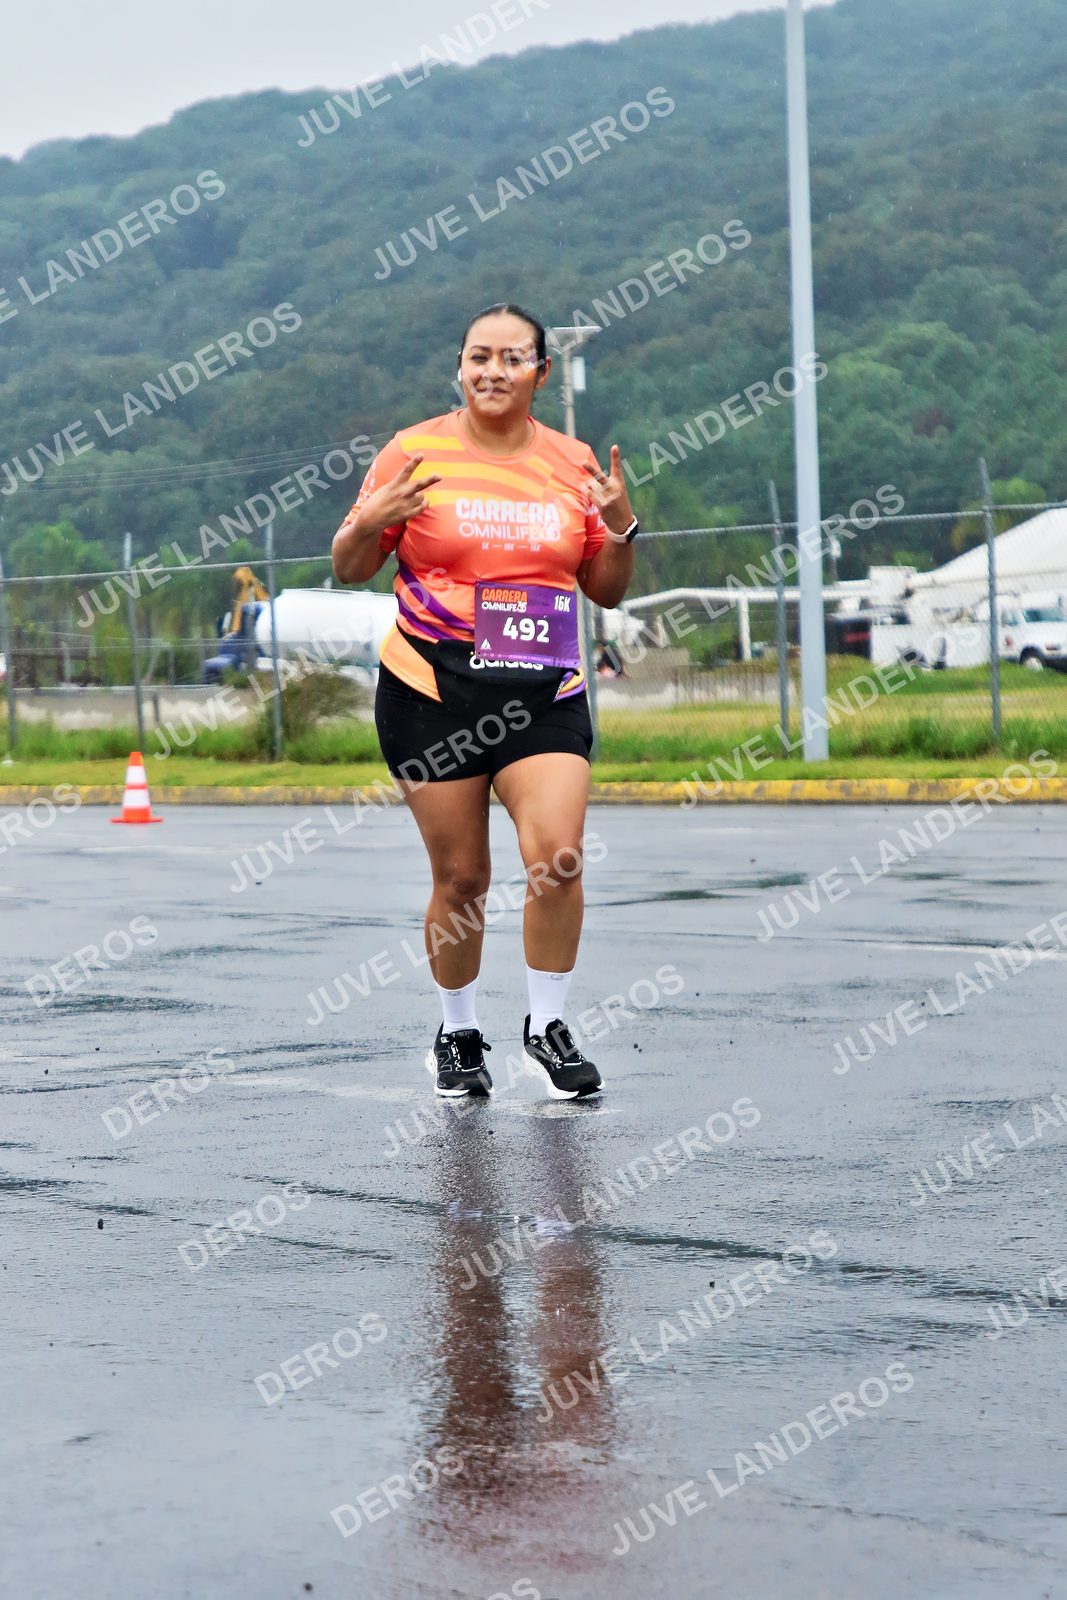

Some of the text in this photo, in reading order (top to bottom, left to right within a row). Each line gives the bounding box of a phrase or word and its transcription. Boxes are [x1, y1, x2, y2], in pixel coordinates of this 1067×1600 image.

[455, 497, 561, 524] CARRERA
[481, 588, 528, 603] CARRERA
[502, 616, 550, 643] 492
